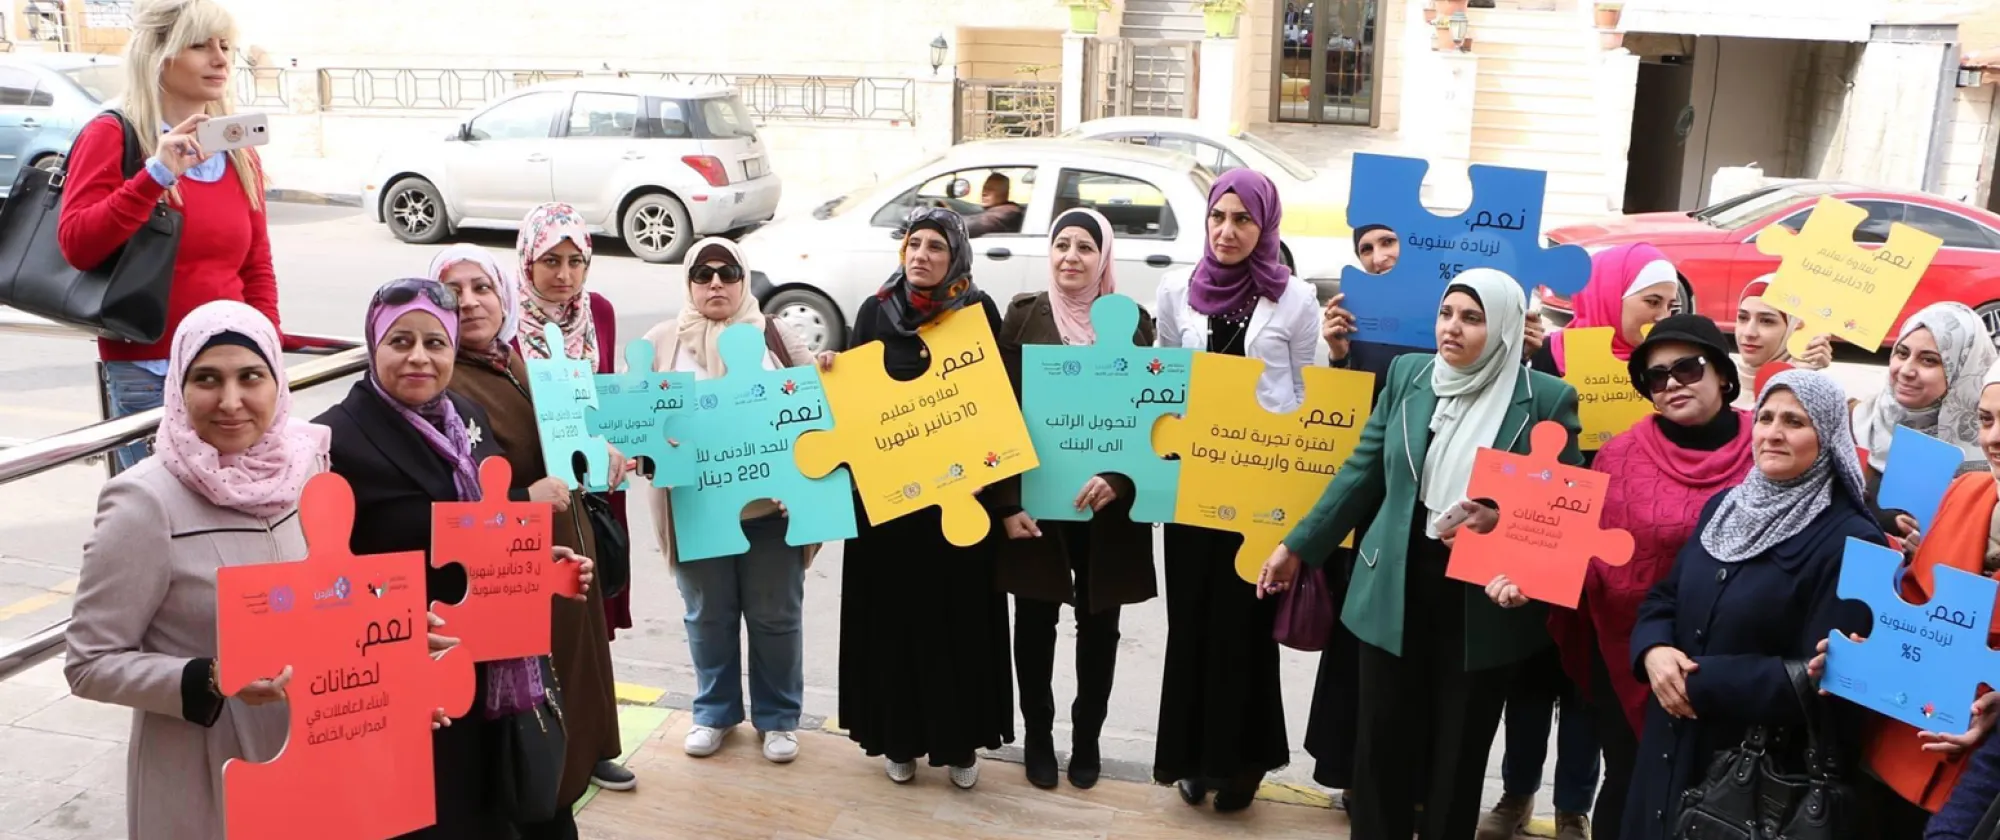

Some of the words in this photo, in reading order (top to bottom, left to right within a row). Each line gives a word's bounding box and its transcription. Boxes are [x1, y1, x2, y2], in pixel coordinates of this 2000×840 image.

[1465, 208, 1526, 232] نعم،
[1408, 232, 1455, 251] سنوية
[1460, 238, 1501, 257] لزيادة
[1871, 250, 1915, 270] نعم،
[935, 341, 985, 381] نعم،
[1612, 375, 1632, 386] ربة
[650, 394, 684, 413] نعم،
[918, 382, 960, 408] لعلاوة
[1130, 383, 1186, 409] نعم،
[769, 399, 823, 431] نعم،
[879, 399, 916, 425] تعليم
[1299, 408, 1356, 429] نعم،
[598, 419, 622, 430] الراتب
[625, 417, 655, 430] لتحويل
[1046, 414, 1085, 430] الراتب
[1088, 415, 1137, 431] لتحويل
[1211, 423, 1247, 440] لمدة
[630, 434, 647, 444] الى
[760, 438, 788, 454] للحد
[874, 422, 920, 452] شهريا
[1060, 437, 1093, 453] البنك
[1098, 439, 1123, 453] الى
[1251, 430, 1290, 448] تجربة
[1295, 435, 1335, 452] لفترة
[714, 441, 755, 462] الأدنى
[1191, 441, 1227, 464] يوما
[1231, 450, 1289, 473] واربعين
[1295, 456, 1341, 476] مسة
[697, 469, 732, 491] دينار
[738, 462, 770, 481] 220
[1547, 496, 1592, 514] نعم،
[1512, 508, 1561, 526] لحضانات
[506, 533, 542, 557] نعم،
[496, 562, 524, 578] دنانير
[526, 561, 533, 573] 3
[471, 584, 502, 598] سنوية
[1879, 612, 1917, 634] سنوية
[1925, 605, 1977, 630] نعم،
[355, 608, 412, 656] نعم،
[1920, 626, 1953, 648] لزيادة
[310, 661, 380, 696] لحضانات
[323, 698, 364, 719] العاملات
[366, 691, 390, 710] لأبناء
[306, 709, 321, 728] في
[345, 716, 387, 740] المدارس
[307, 725, 344, 746] الخاصة
